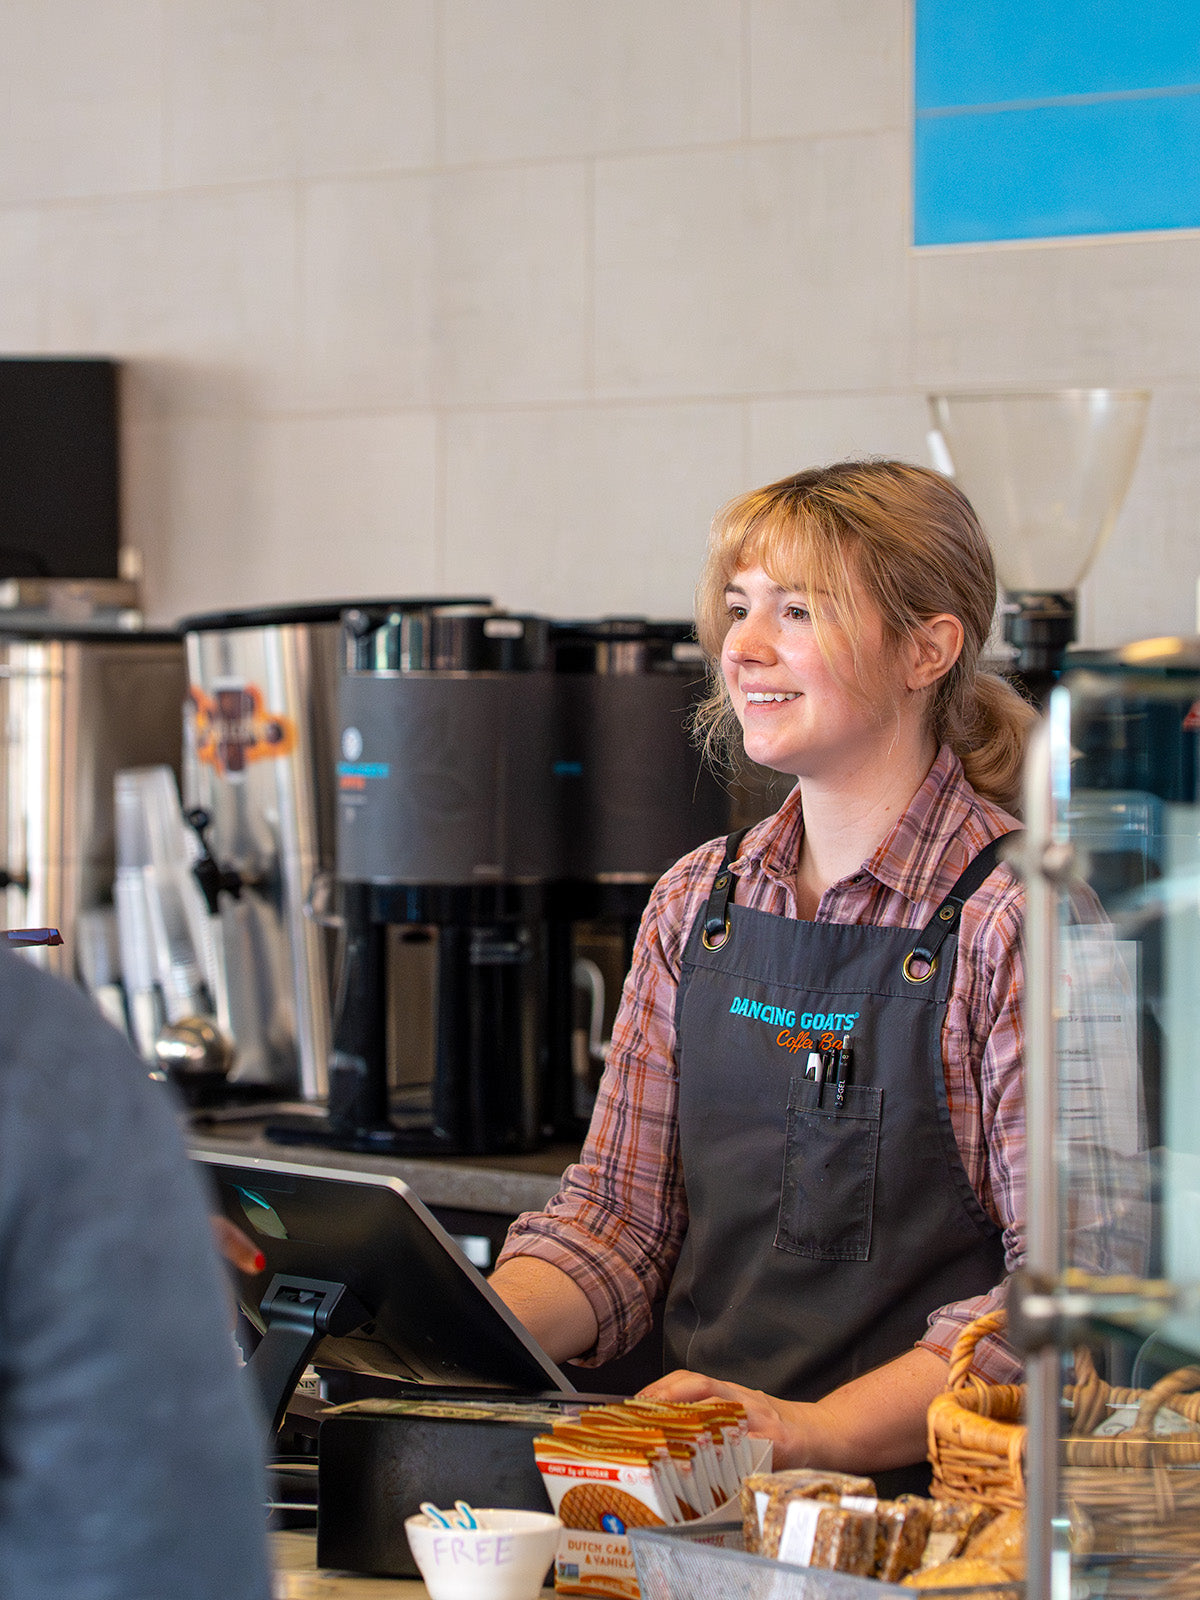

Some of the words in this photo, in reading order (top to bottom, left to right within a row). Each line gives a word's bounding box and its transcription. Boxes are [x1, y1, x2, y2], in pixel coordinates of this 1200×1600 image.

[729, 996, 796, 1028] DANCING
[819, 1032, 843, 1050] Ba
[433, 1536, 514, 1567] FREE
[567, 1539, 602, 1552] DUTCH
